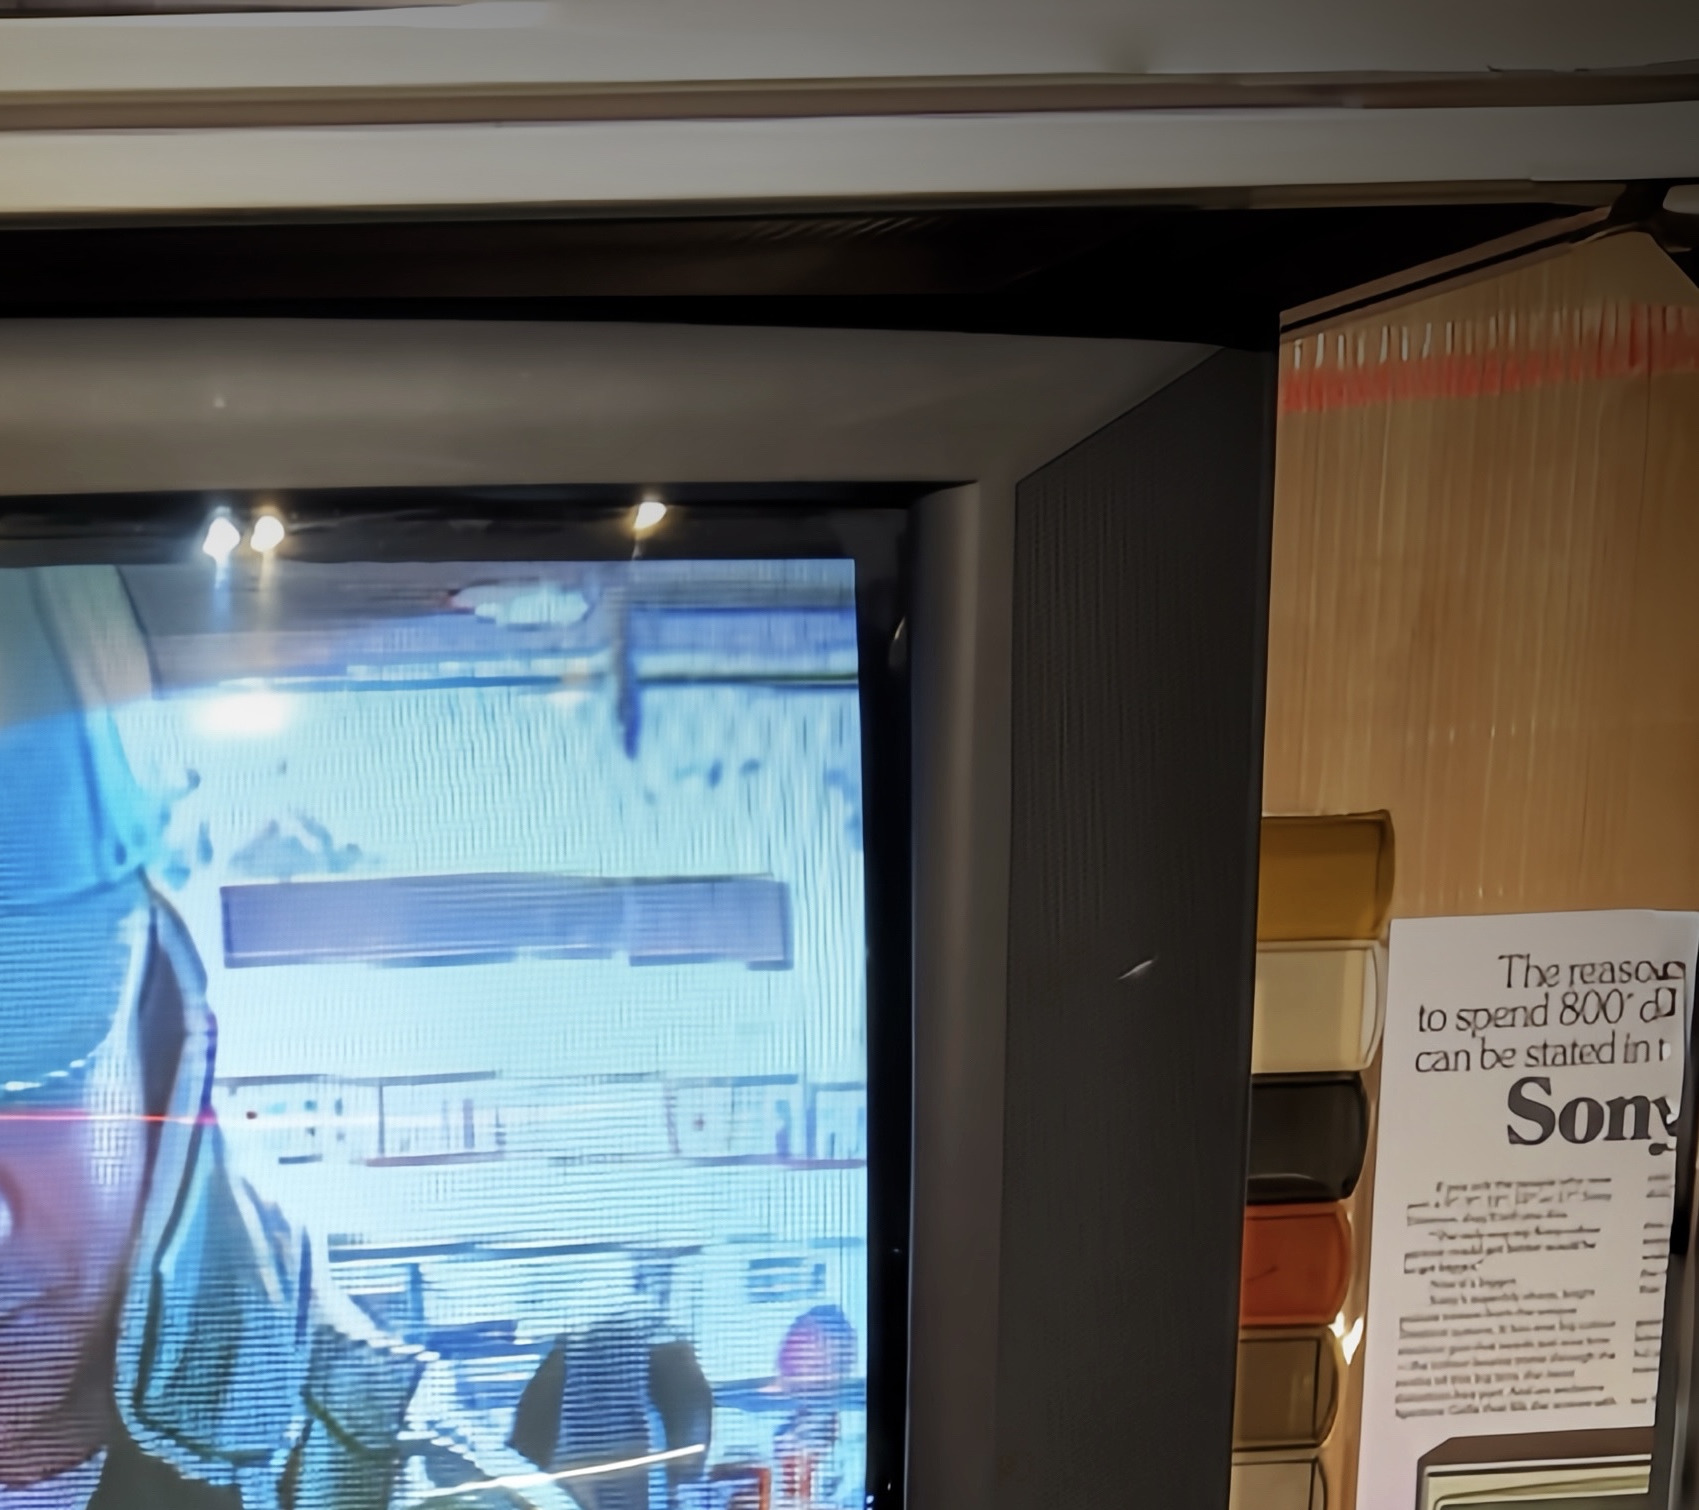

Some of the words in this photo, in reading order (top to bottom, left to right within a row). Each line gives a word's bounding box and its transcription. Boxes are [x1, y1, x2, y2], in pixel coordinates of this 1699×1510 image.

[1498, 953, 1560, 988] The
[1418, 1004, 1447, 1032] to
[1455, 992, 1549, 1038] spend
[1415, 1048, 1470, 1073] can
[1480, 1036, 1516, 1070] be
[1524, 1029, 1615, 1067] stated
[1622, 1033, 1650, 1064] in
[1507, 1076, 1678, 1156] Sony
